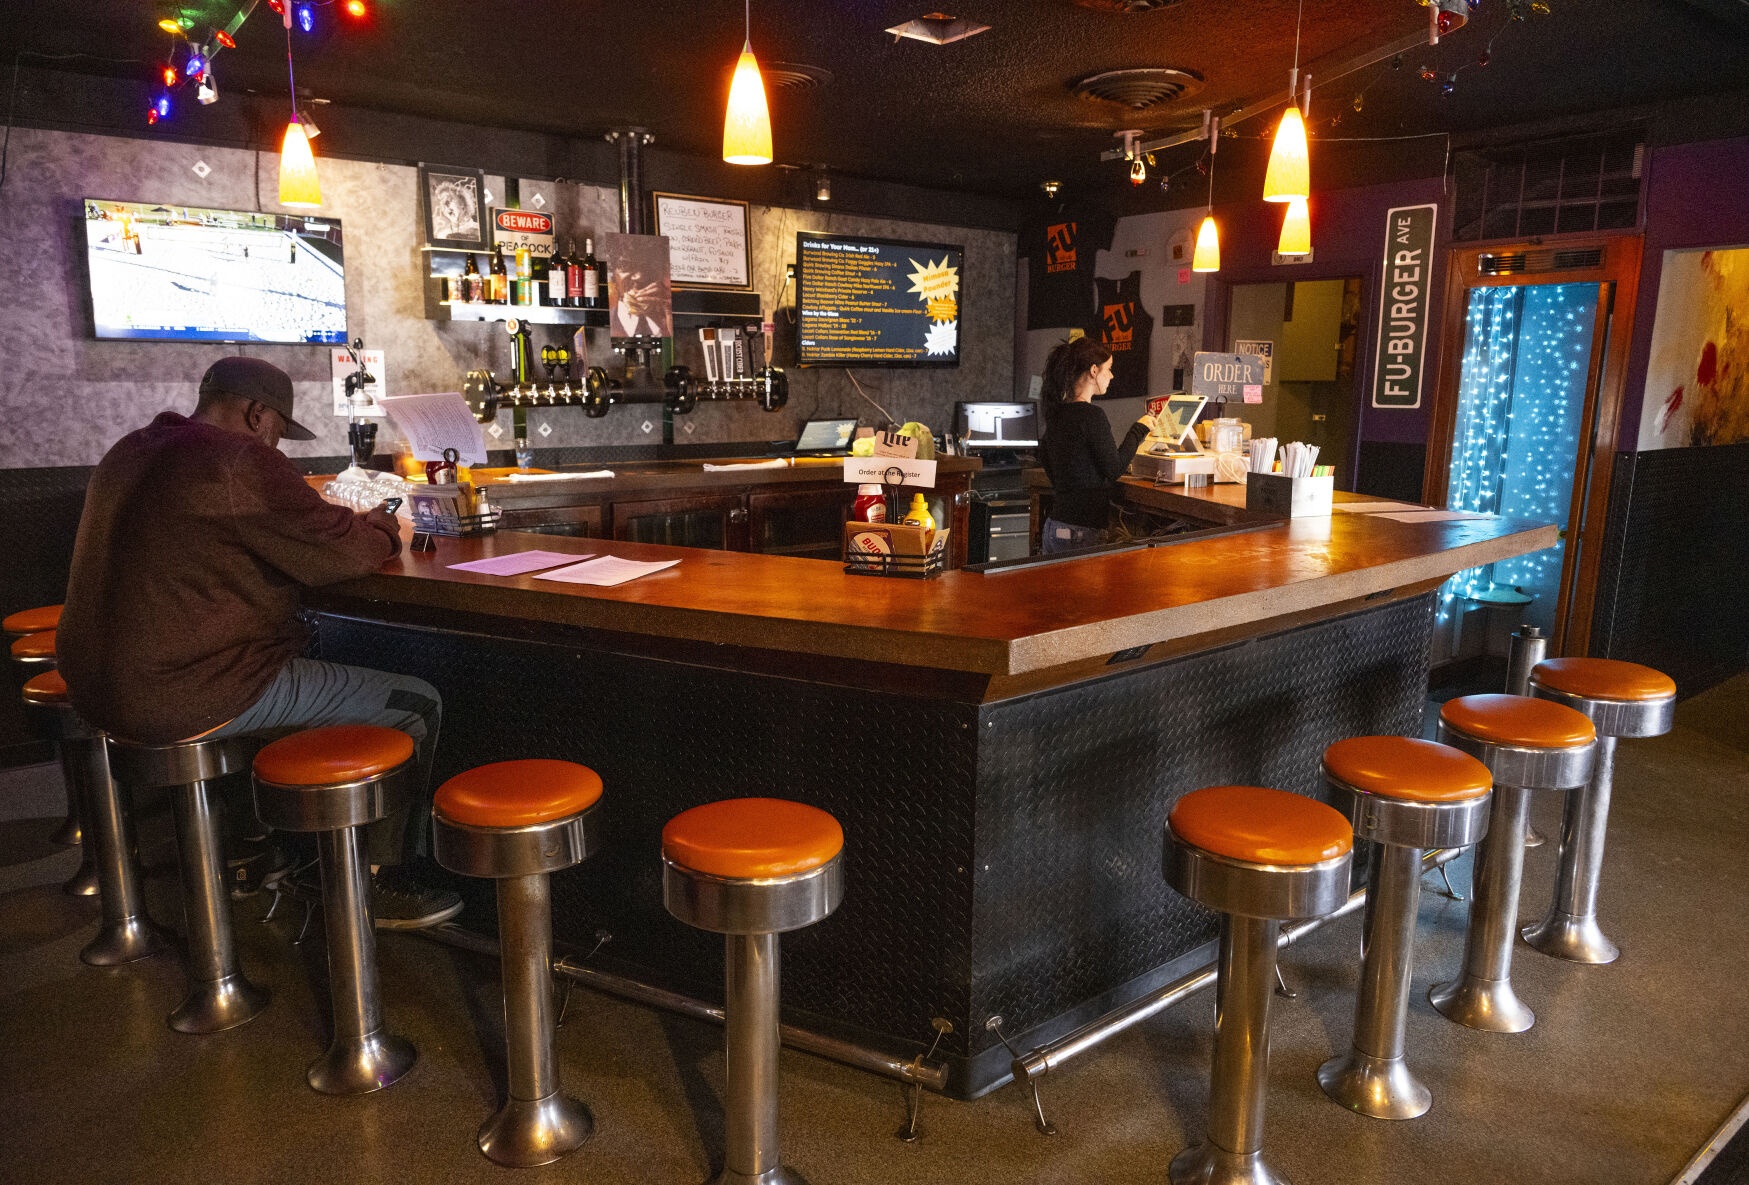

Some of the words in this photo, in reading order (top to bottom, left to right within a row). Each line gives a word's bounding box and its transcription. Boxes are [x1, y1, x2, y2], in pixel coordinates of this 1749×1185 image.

[502, 214, 546, 230] BEWARE
[1396, 216, 1412, 244] AVE
[922, 271, 949, 282] Mimosa
[924, 280, 951, 293] Pounder
[1384, 248, 1422, 396] FU-BURGER
[1240, 344, 1270, 355] NOTICE
[736, 358, 744, 372] CIDER
[1204, 362, 1252, 383] ORDER
[1218, 384, 1238, 394] HERE
